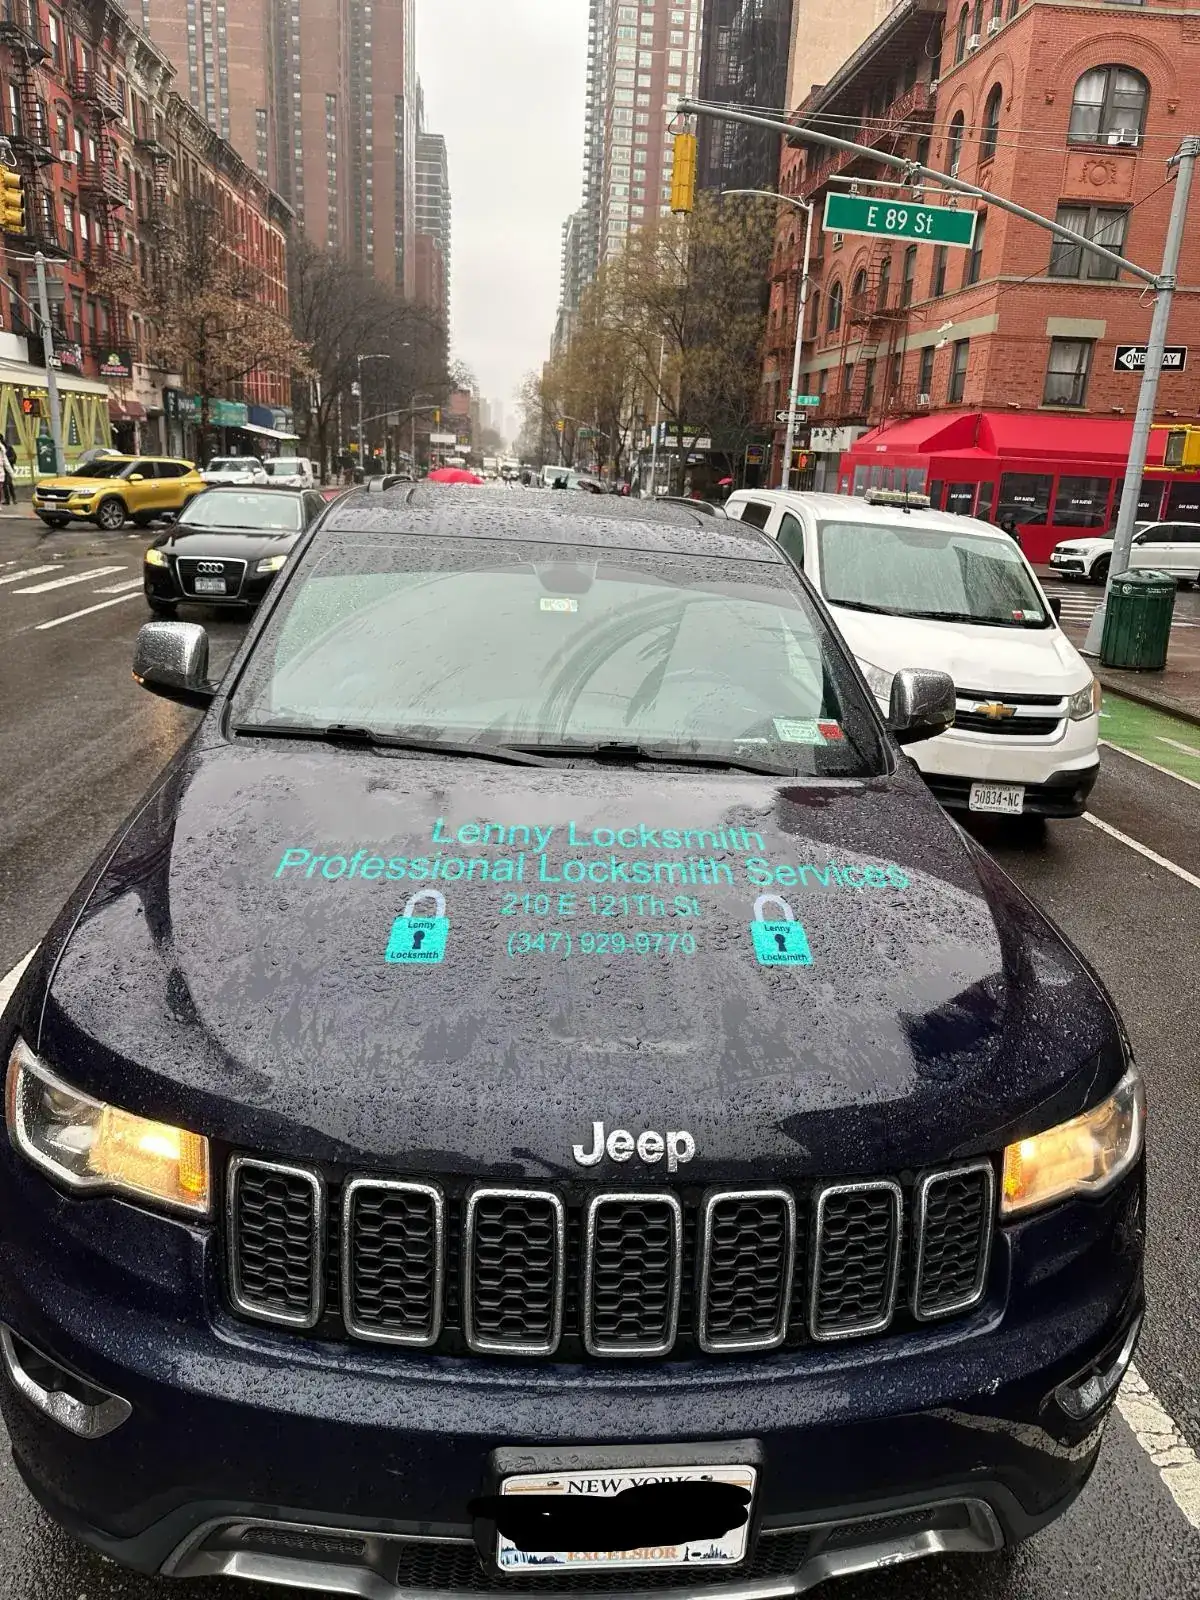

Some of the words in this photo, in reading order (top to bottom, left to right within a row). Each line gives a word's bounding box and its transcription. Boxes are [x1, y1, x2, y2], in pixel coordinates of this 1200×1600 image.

[867, 206, 879, 227] E
[885, 208, 908, 230] 89
[914, 212, 934, 234] St
[1125, 353, 1146, 364] ONE
[1162, 354, 1177, 364] AY
[431, 816, 553, 853] Lenny
[567, 821, 766, 851] Locksmith
[273, 847, 526, 882] Professional
[539, 853, 734, 886] Locksmith
[745, 856, 911, 889] Services
[500, 892, 551, 916] 210
[557, 892, 576, 915] E
[587, 893, 666, 917] 121Th
[674, 895, 702, 917] St
[407, 920, 436, 930] Lenny
[763, 924, 790, 934] Lenny
[506, 930, 572, 959] (347)
[580, 930, 697, 957] 929-9770
[390, 951, 439, 959] Locksmith
[761, 953, 808, 962] Locksmith
[572, 1121, 696, 1173] Jeep
[567, 1478, 622, 1494] NEW
